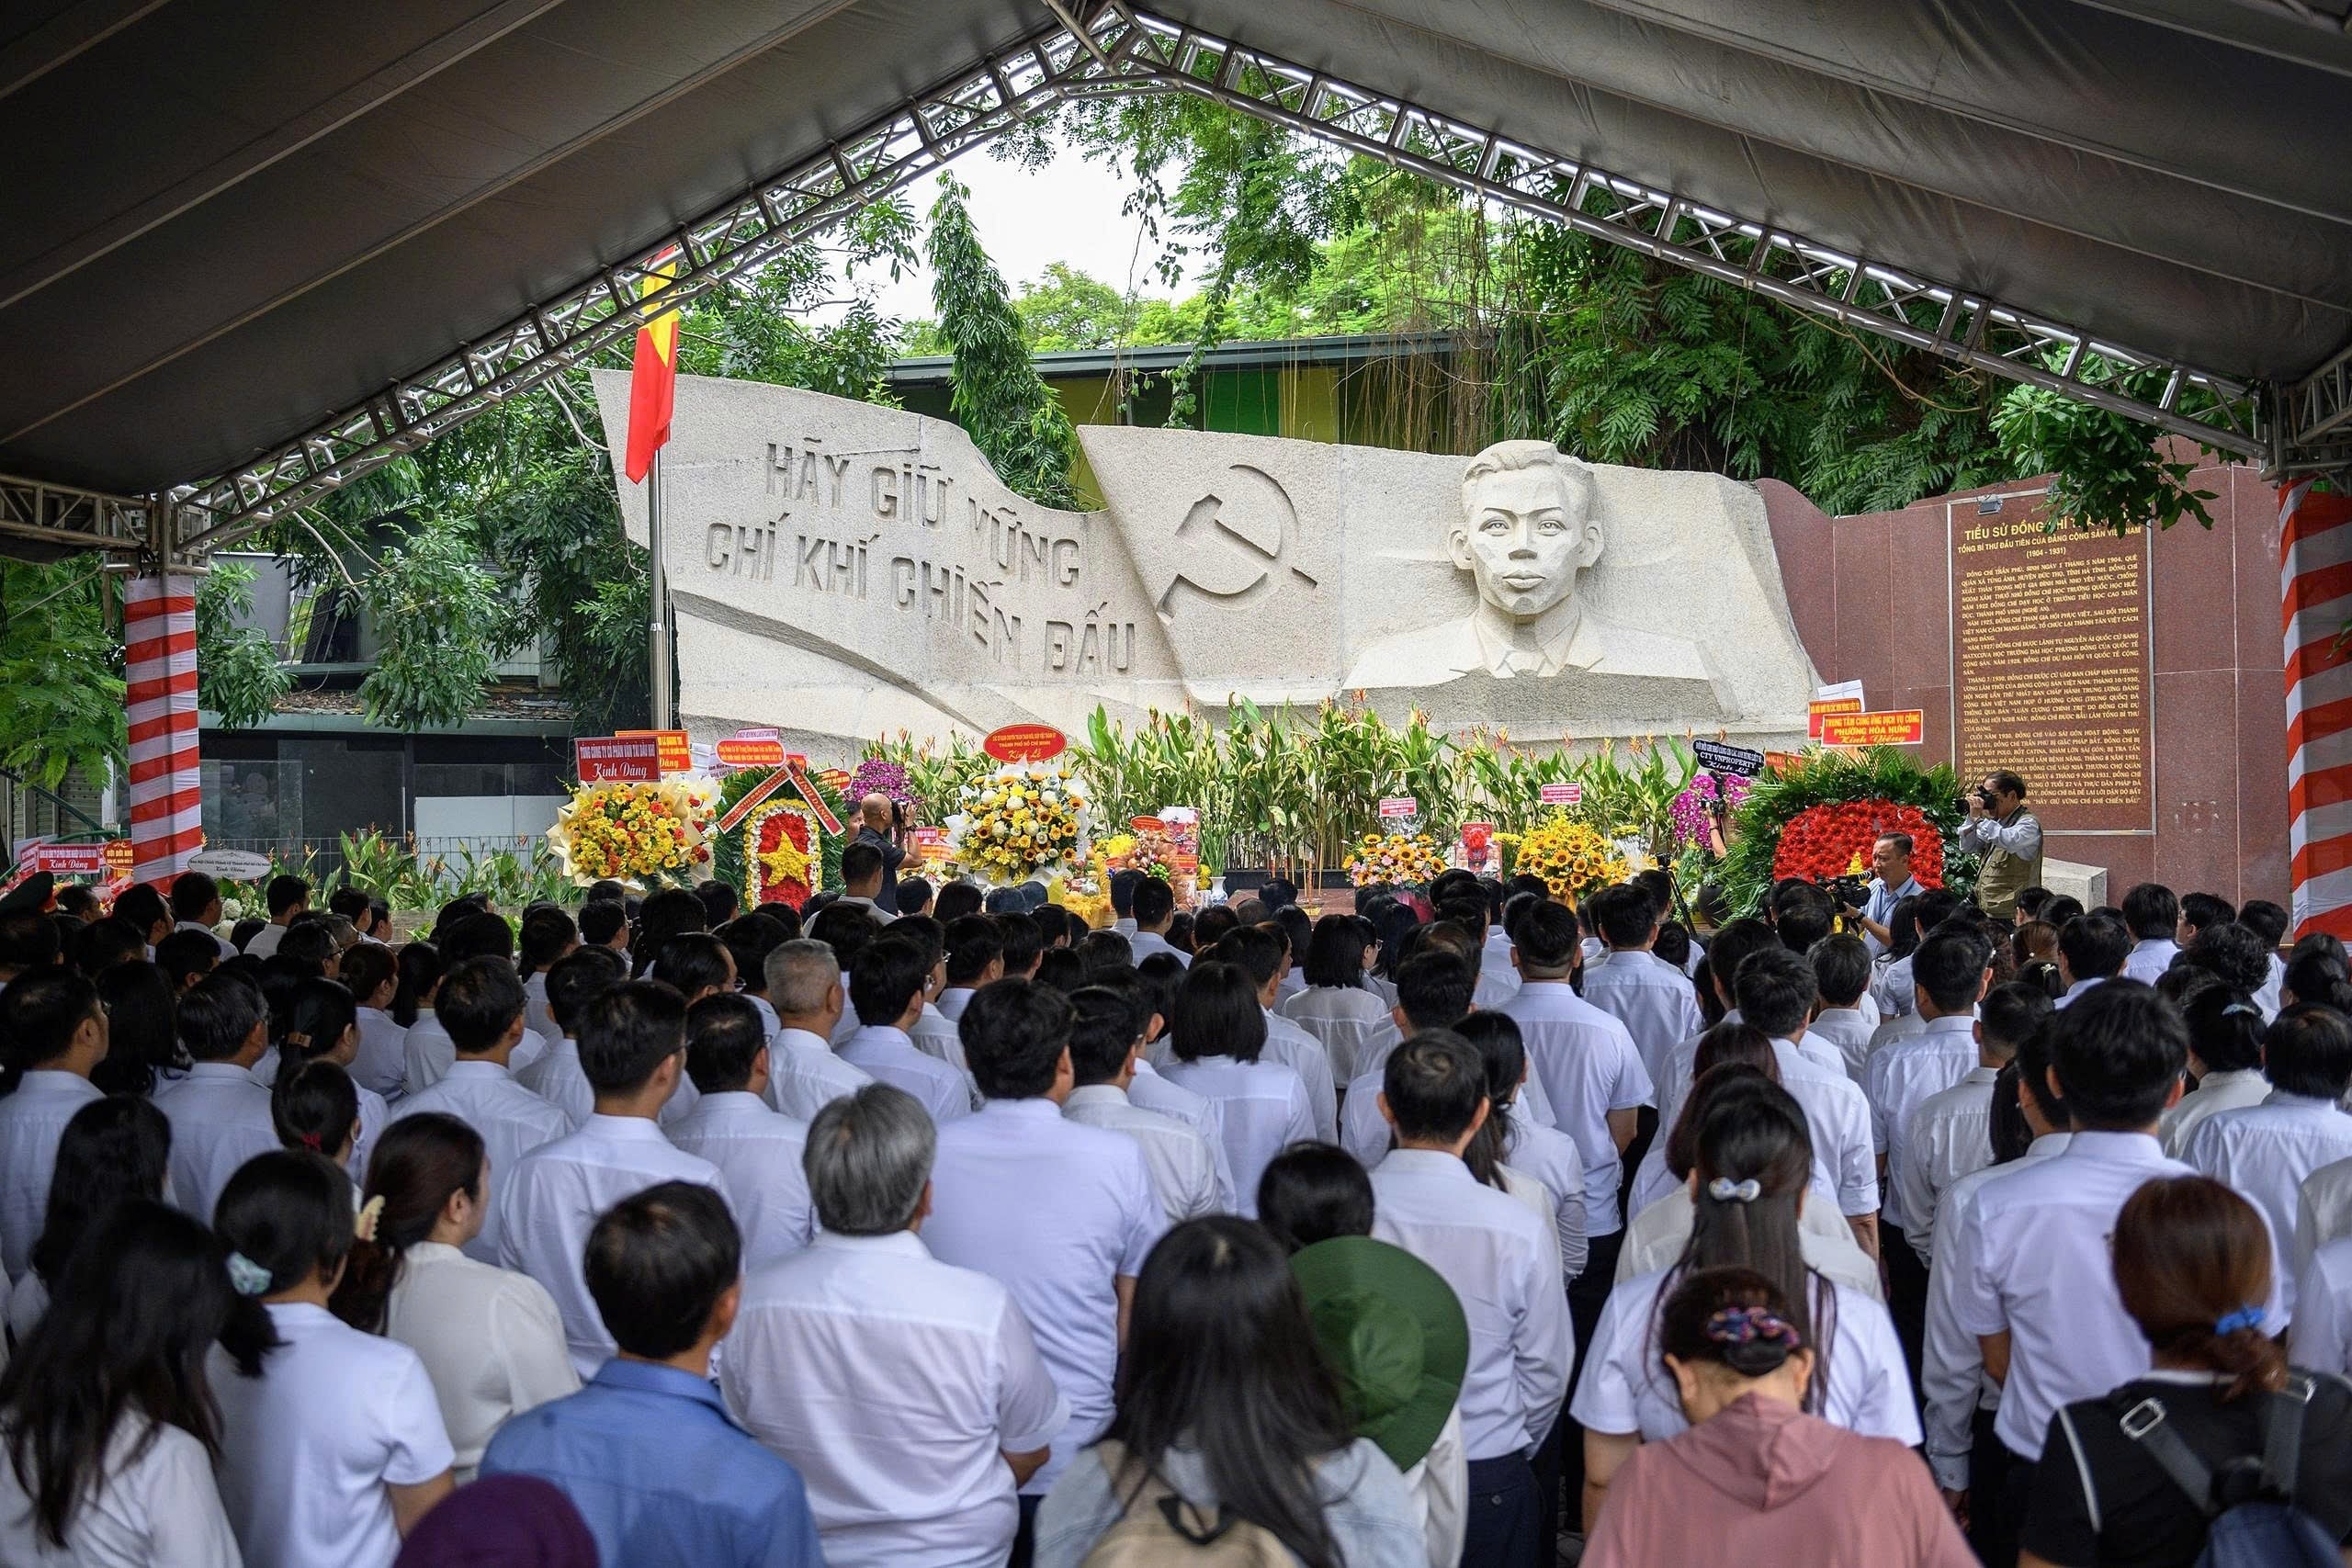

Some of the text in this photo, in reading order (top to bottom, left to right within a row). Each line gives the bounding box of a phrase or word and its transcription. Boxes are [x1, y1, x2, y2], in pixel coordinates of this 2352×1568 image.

[766, 437, 1080, 585] HÃY GIỮ VỮNG
[1965, 524, 1989, 540] TIỂU
[1992, 523, 2009, 537] SỬ
[2011, 519, 2045, 535] ĐỒNG
[2069, 532, 2089, 541] CỘNG
[707, 512, 791, 581] CHÍ
[795, 534, 881, 600] KHÍ
[1045, 602, 1136, 678] ĐẤU
[1869, 726, 1886, 734] HÒA
[1714, 754, 1756, 768] VNPROPERTY
